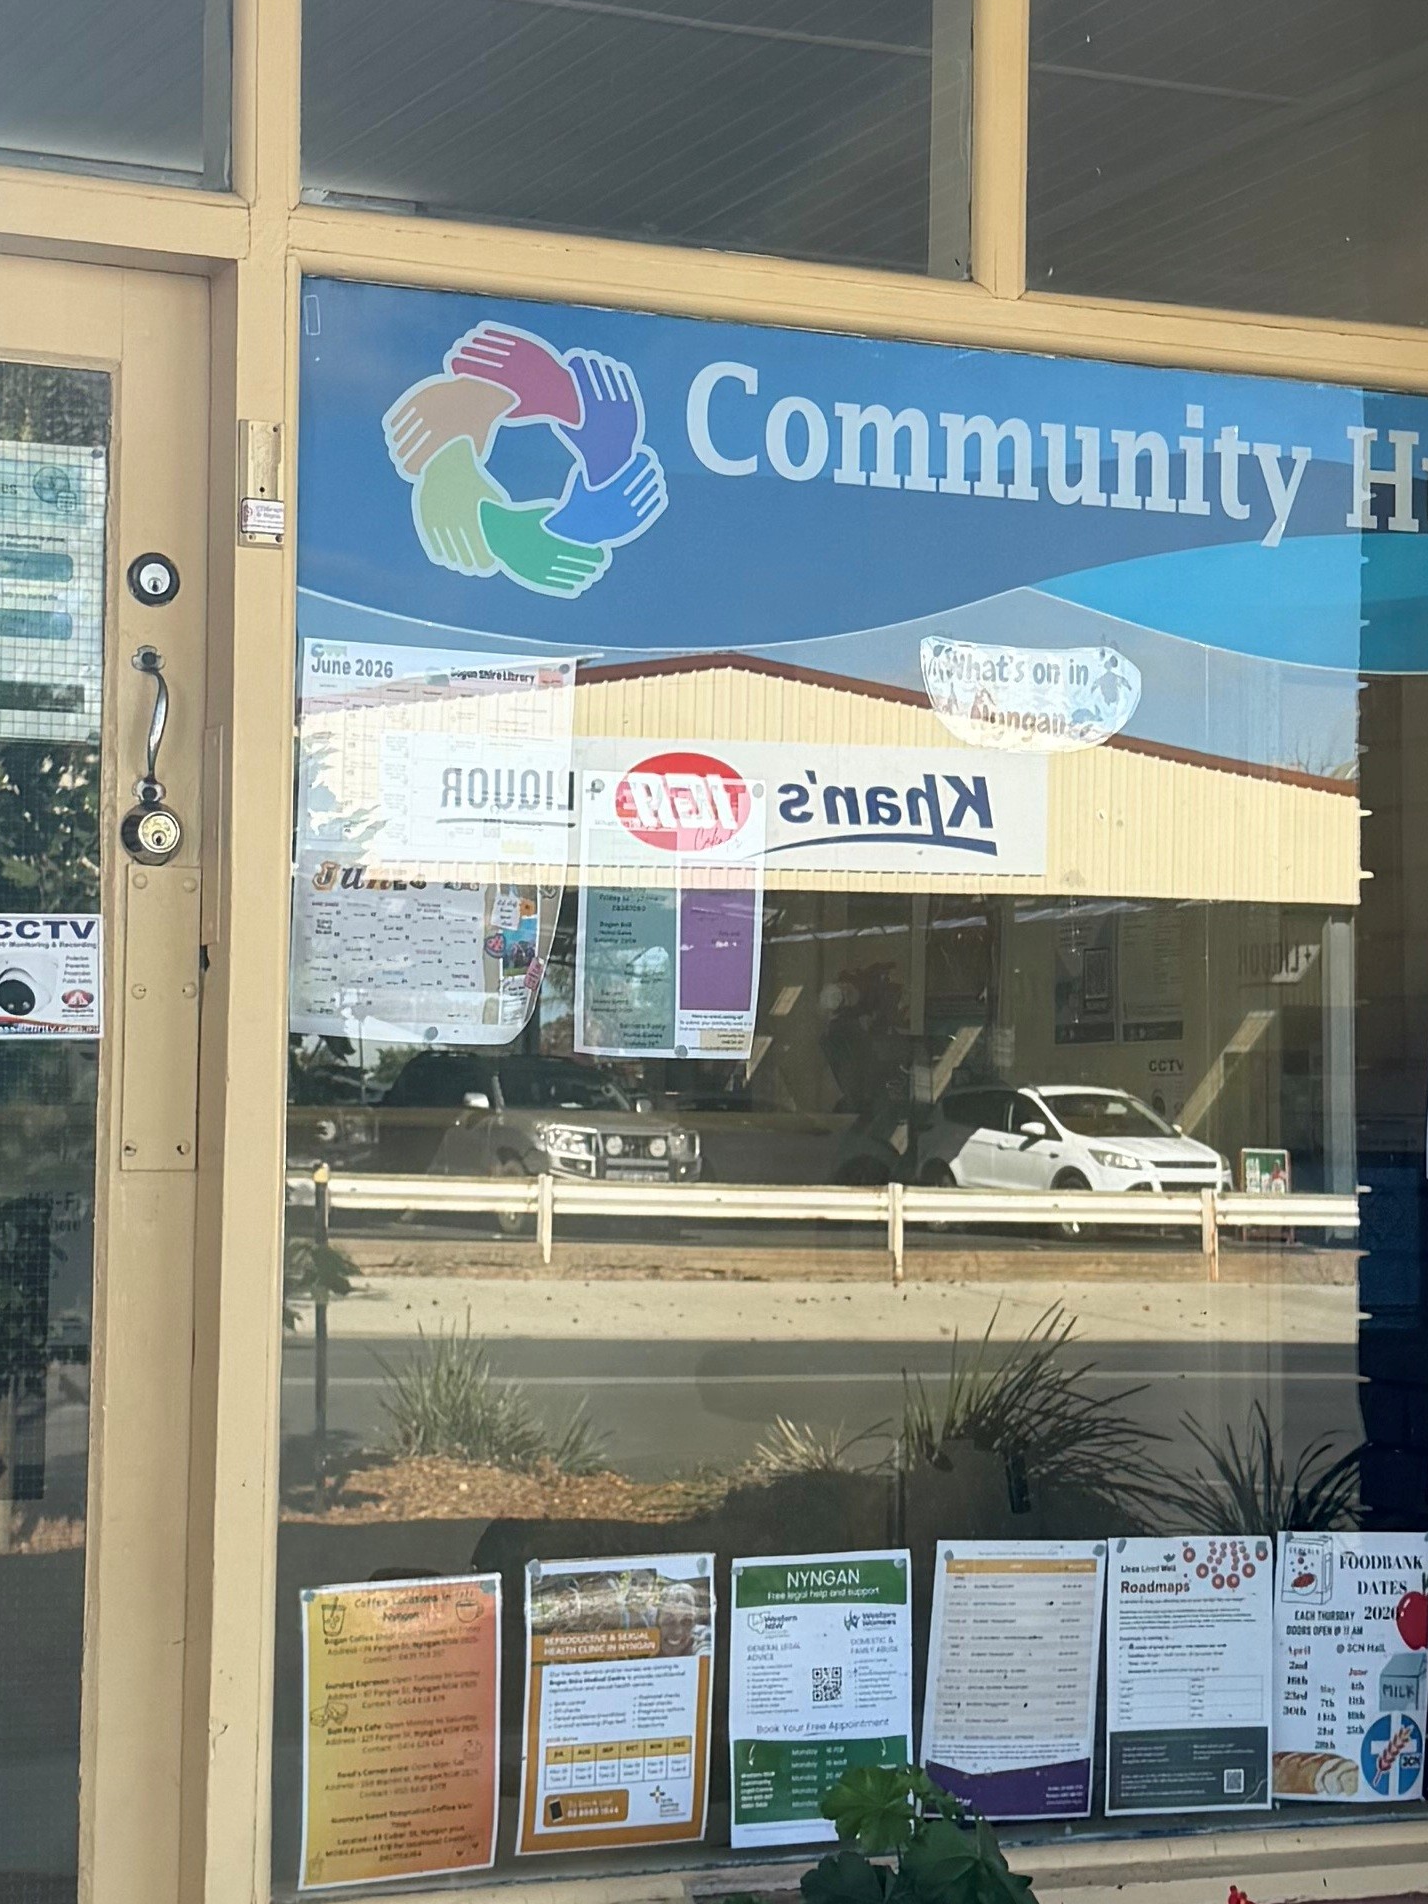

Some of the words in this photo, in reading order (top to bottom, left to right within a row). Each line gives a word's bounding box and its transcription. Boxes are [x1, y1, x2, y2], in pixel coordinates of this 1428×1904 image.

[687, 361, 1311, 547] Community
[311, 657, 351, 675] June
[355, 659, 393, 678] 2026
[1033, 661, 1061, 686] on
[1069, 658, 1089, 686] in
[1148, 1059, 1184, 1073] CCTV
[1340, 1554, 1423, 1570] FOODBANK
[787, 1568, 860, 1588] NYNGAN
[768, 1592, 786, 1601] Free
[787, 1590, 809, 1602] legal
[810, 1588, 828, 1600] help
[830, 1588, 846, 1598] and
[848, 1586, 880, 1599] support
[1121, 1580, 1190, 1596] Roadmaps
[1357, 1580, 1408, 1595] DATES
[1295, 1610, 1315, 1621] EACH
[1317, 1610, 1355, 1621] THURSDAY
[1313, 1625, 1332, 1636] OPEN
[1382, 1683, 1416, 1699] MILK
[783, 1723, 804, 1733] Your
[806, 1722, 826, 1732] Free
[828, 1718, 889, 1732] Appointment
